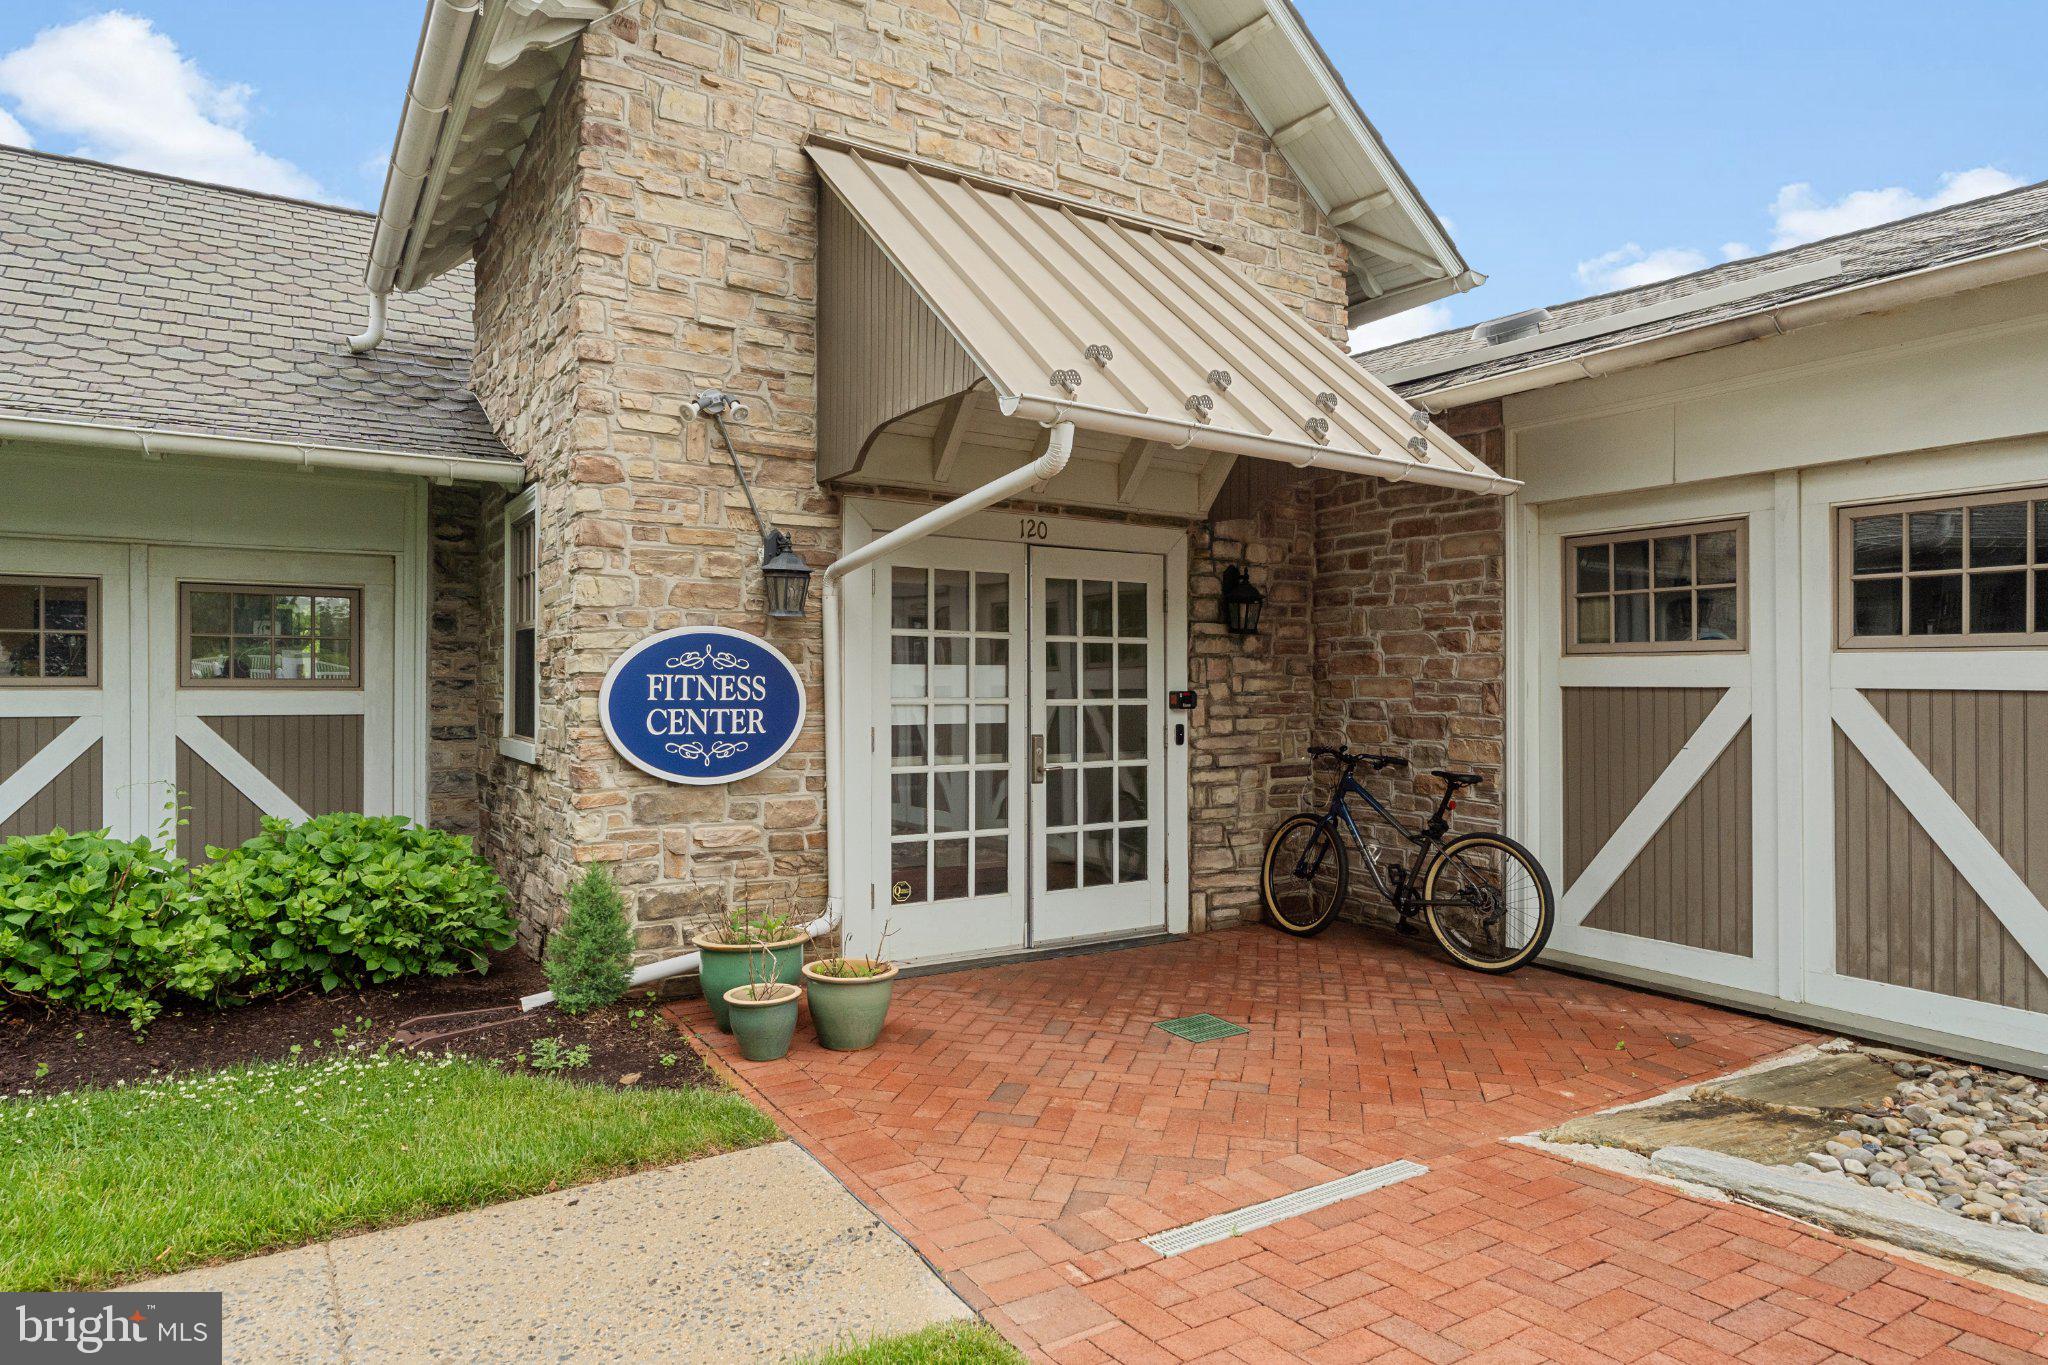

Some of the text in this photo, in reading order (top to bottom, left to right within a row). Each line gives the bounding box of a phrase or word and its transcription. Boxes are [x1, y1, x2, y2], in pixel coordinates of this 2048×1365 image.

[1020, 518, 1048, 540] 120
[646, 673, 766, 702] FITNESS
[646, 708, 766, 735] CENTER
